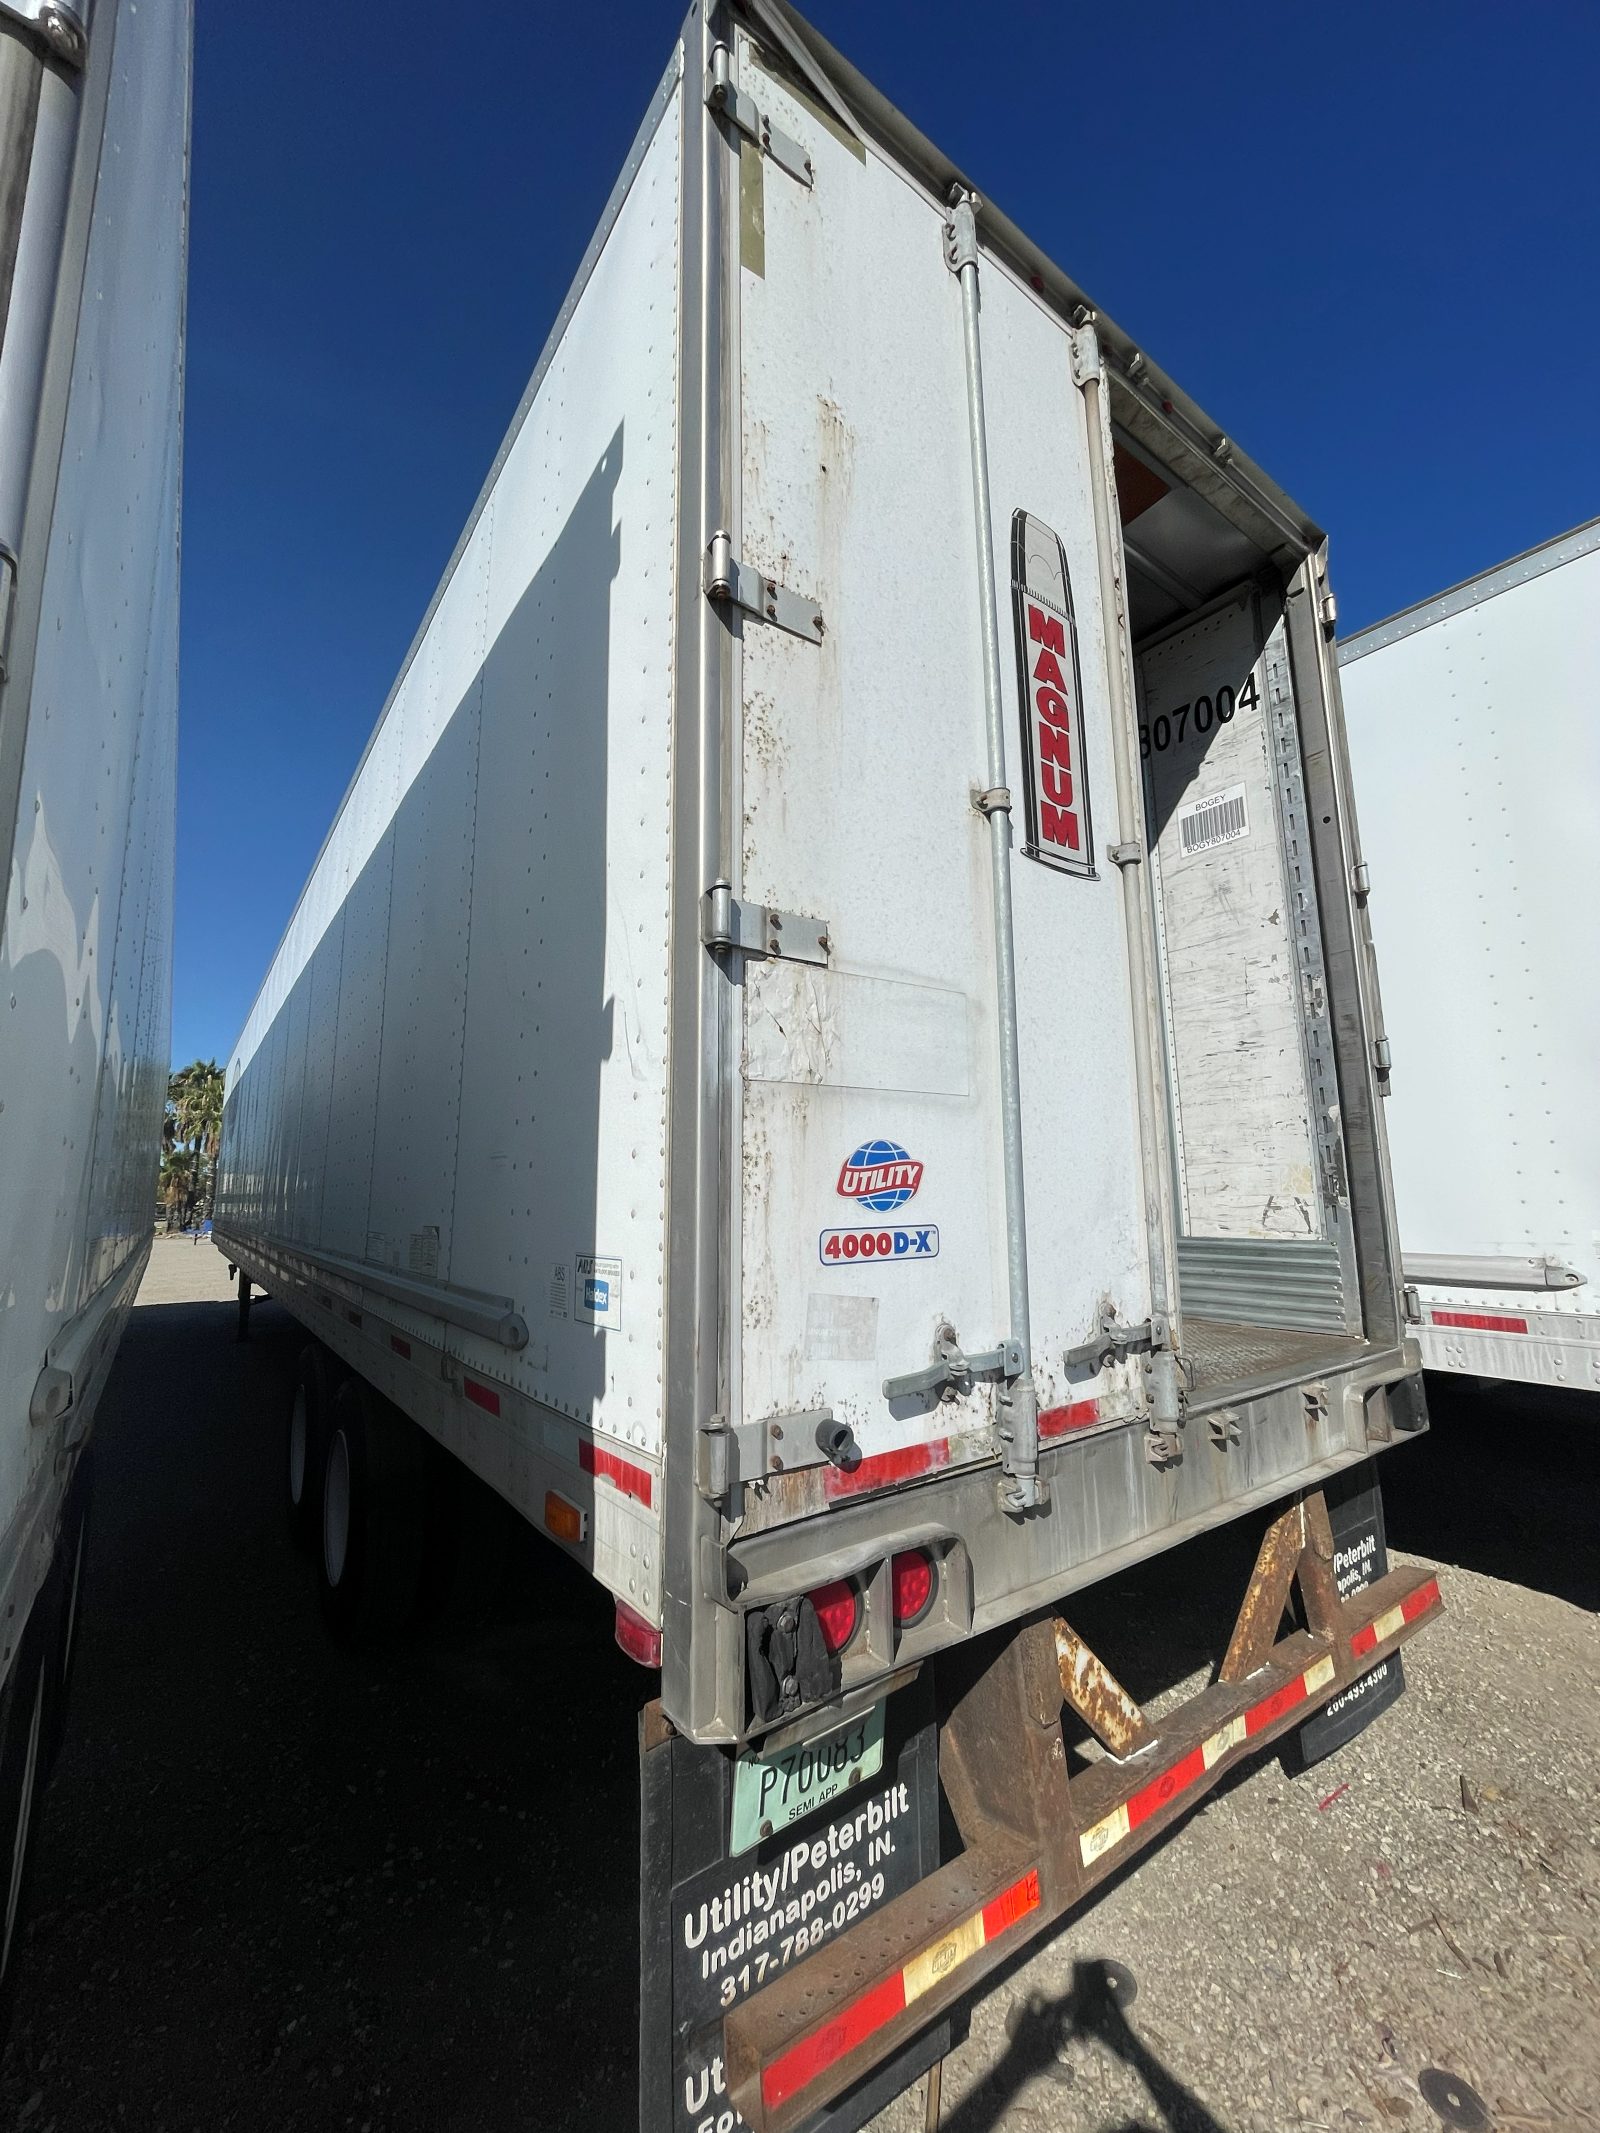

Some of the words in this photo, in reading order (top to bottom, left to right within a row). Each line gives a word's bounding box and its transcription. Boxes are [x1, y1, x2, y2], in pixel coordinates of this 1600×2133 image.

[1028, 603, 1080, 851] MAGNUM
[1186, 828, 1241, 854] BOGY807004
[1195, 794, 1226, 812] BOGEY
[842, 1165, 919, 1193] UTILITY
[788, 1796, 815, 1821] SEMI
[818, 1783, 838, 1803] APP
[684, 1782, 910, 1949] Utility/Peterbilt
[702, 1861, 862, 1980] Indianapolis,
[868, 1831, 896, 1867] IN.
[720, 1873, 886, 2007] 317-788-0299
